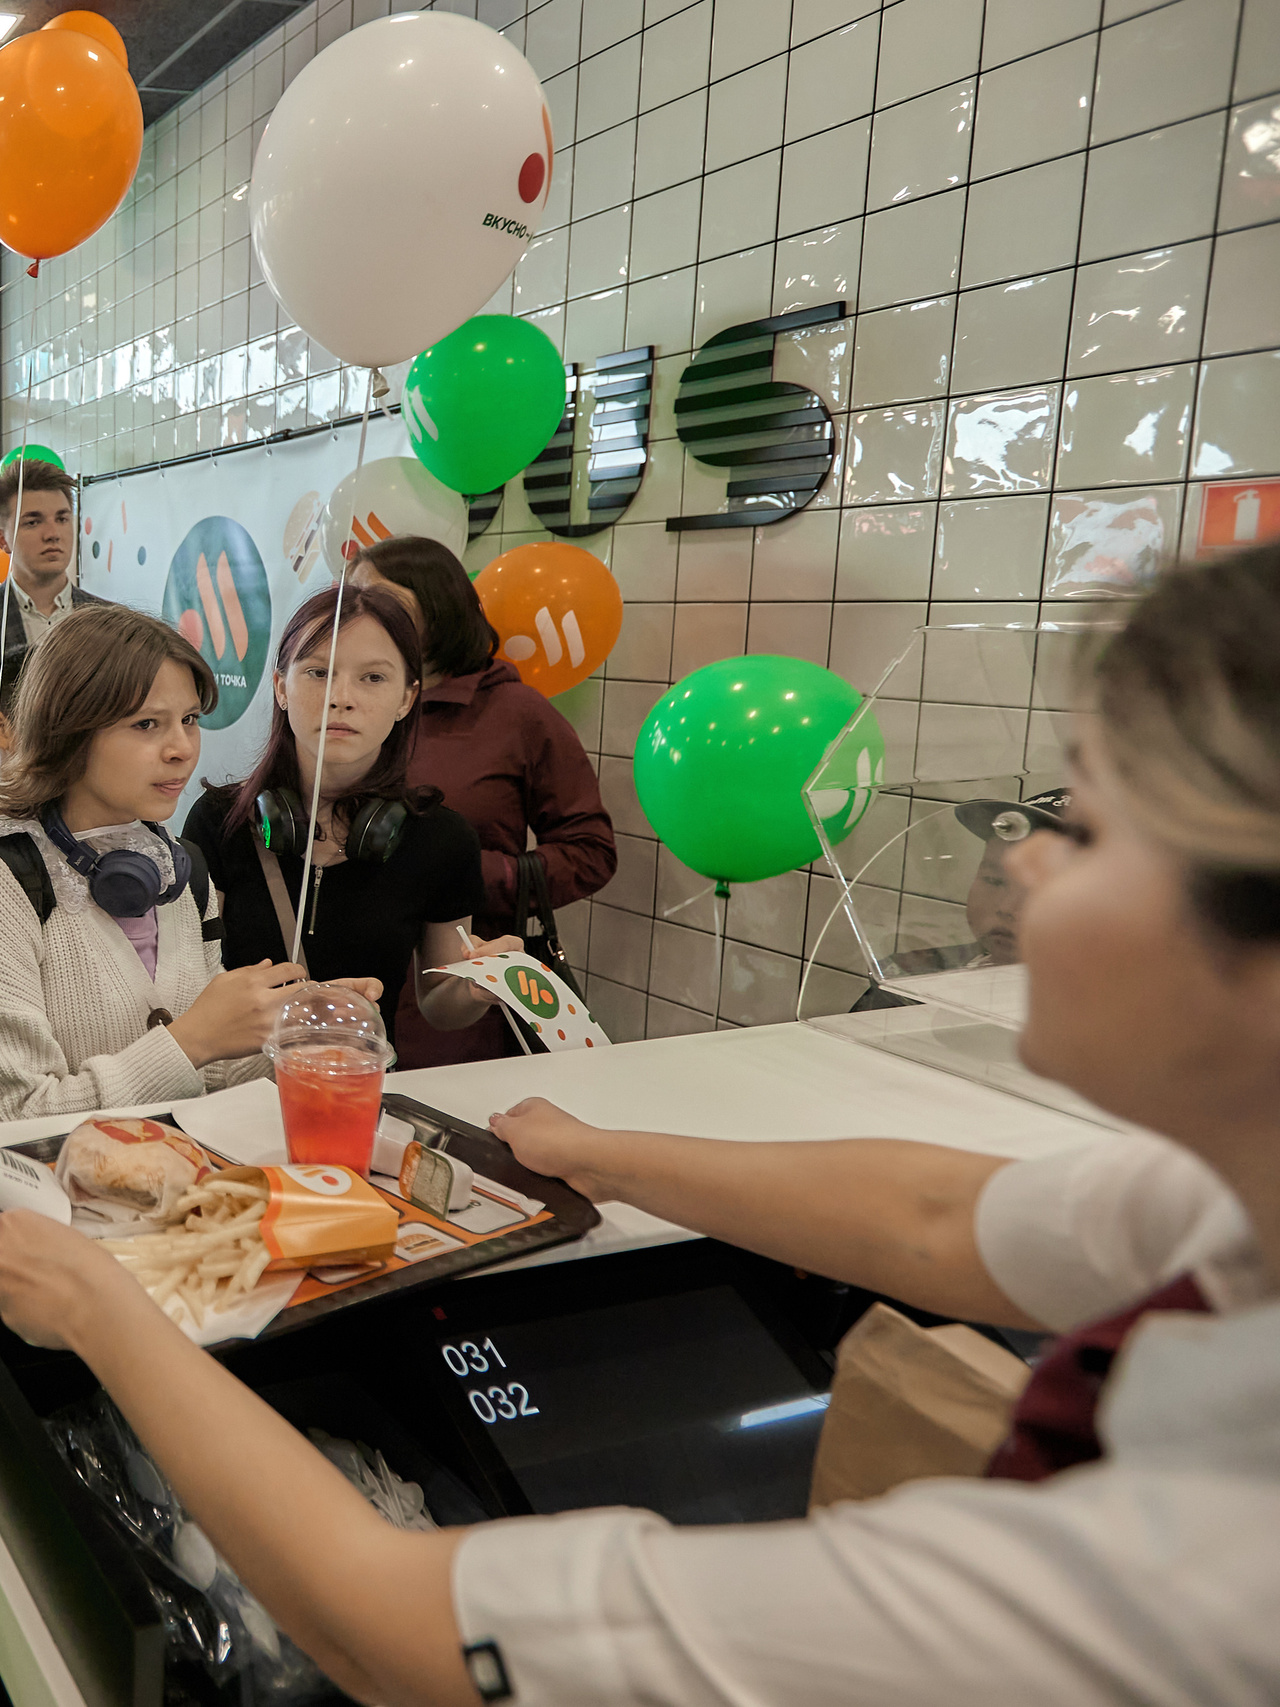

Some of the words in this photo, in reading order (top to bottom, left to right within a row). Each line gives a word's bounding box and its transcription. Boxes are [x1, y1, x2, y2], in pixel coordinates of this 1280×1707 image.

[220, 673, 247, 688] ТОЧКА
[441, 1336, 507, 1377] 031
[468, 1381, 540, 1425] 032
